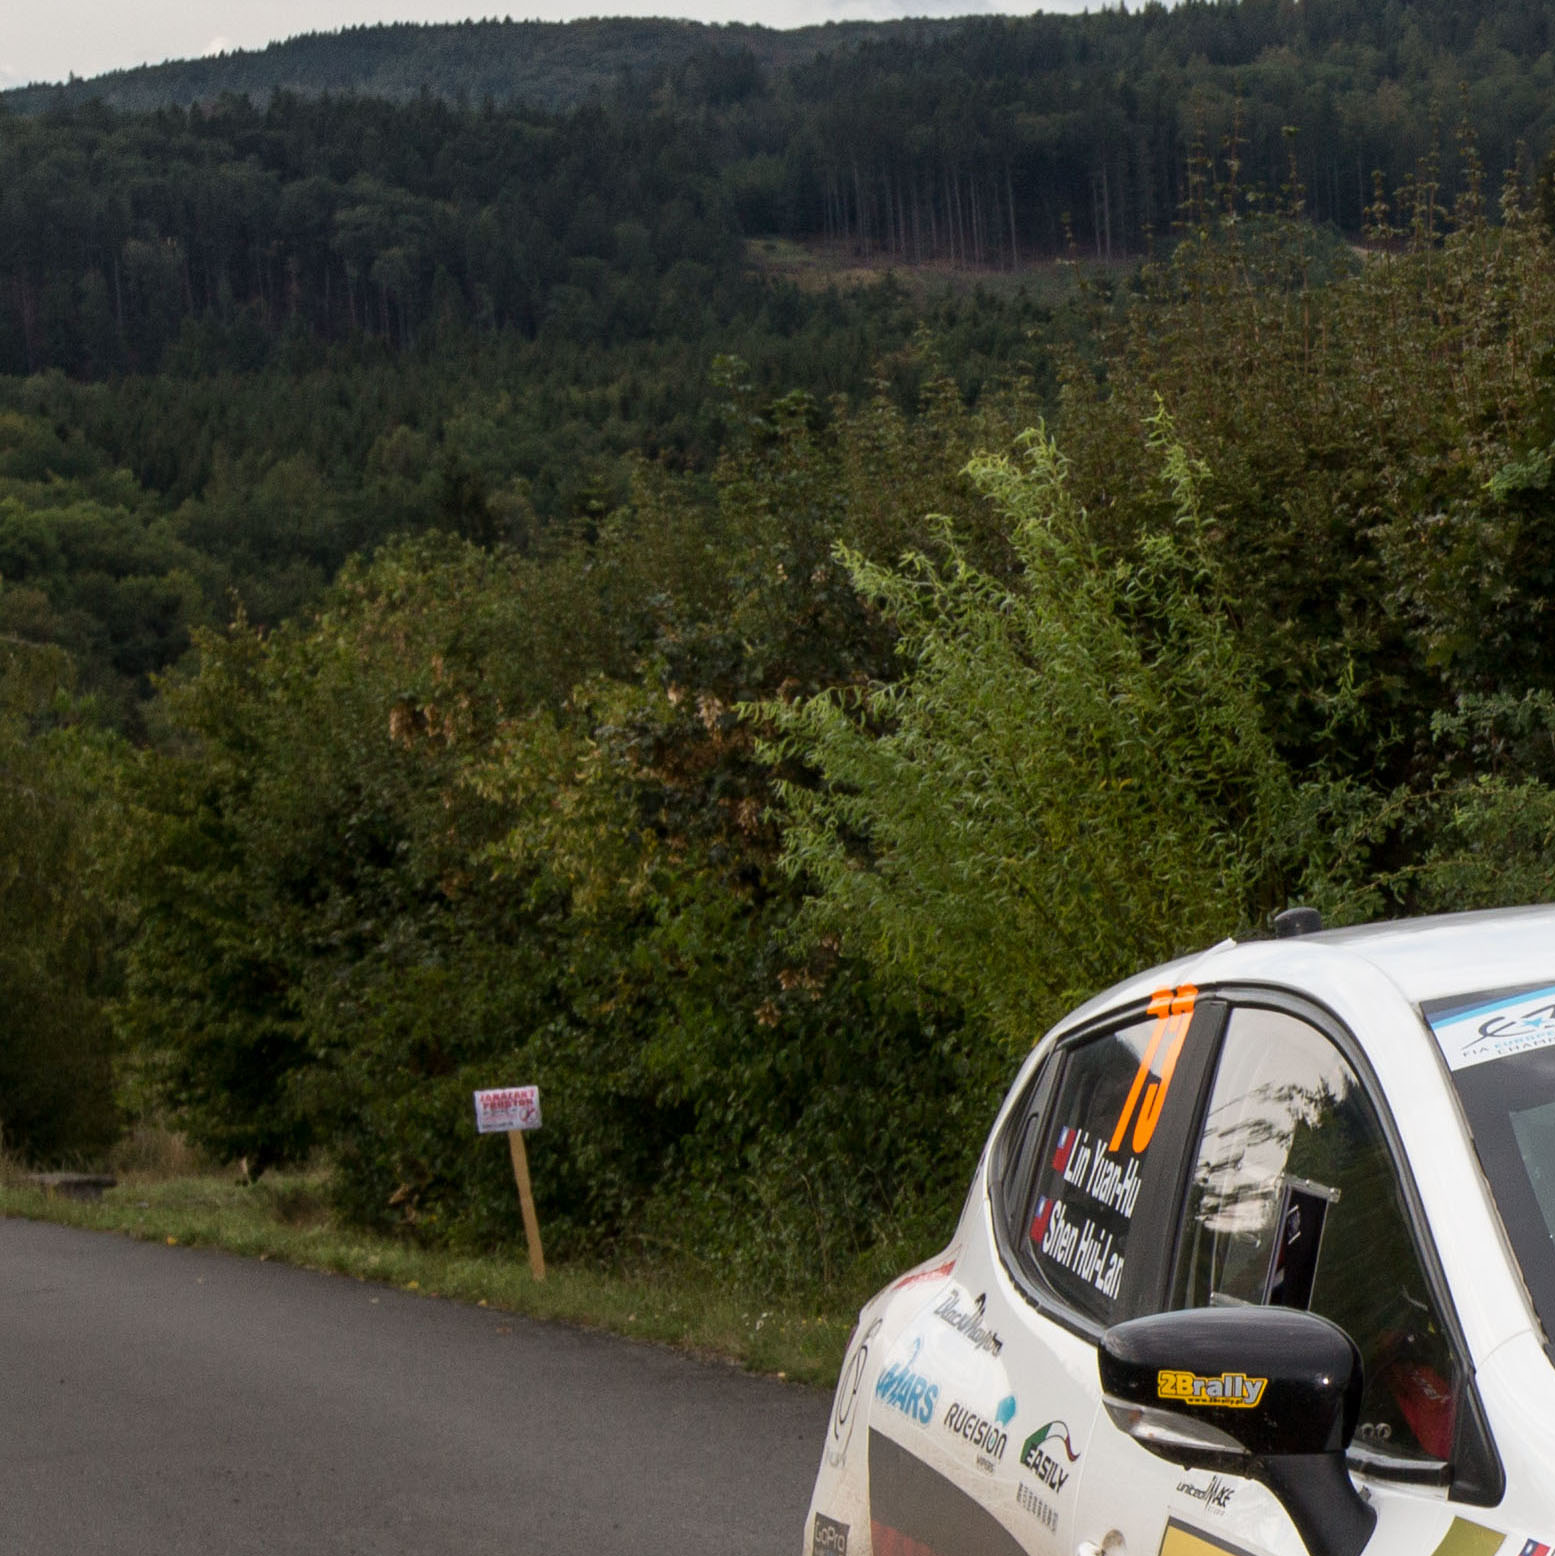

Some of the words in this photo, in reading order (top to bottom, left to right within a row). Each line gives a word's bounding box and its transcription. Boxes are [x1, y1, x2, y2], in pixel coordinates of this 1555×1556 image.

[1462, 1046, 1489, 1058] FIA
[1064, 1128, 1091, 1188] Lin
[1086, 1138, 1142, 1220] Yuan-Hu
[1042, 1199, 1080, 1268] Shen
[1072, 1218, 1124, 1301] Hui-Lan
[1158, 1372, 1264, 1405] 2Brally
[1024, 1442, 1070, 1495] EASILY
